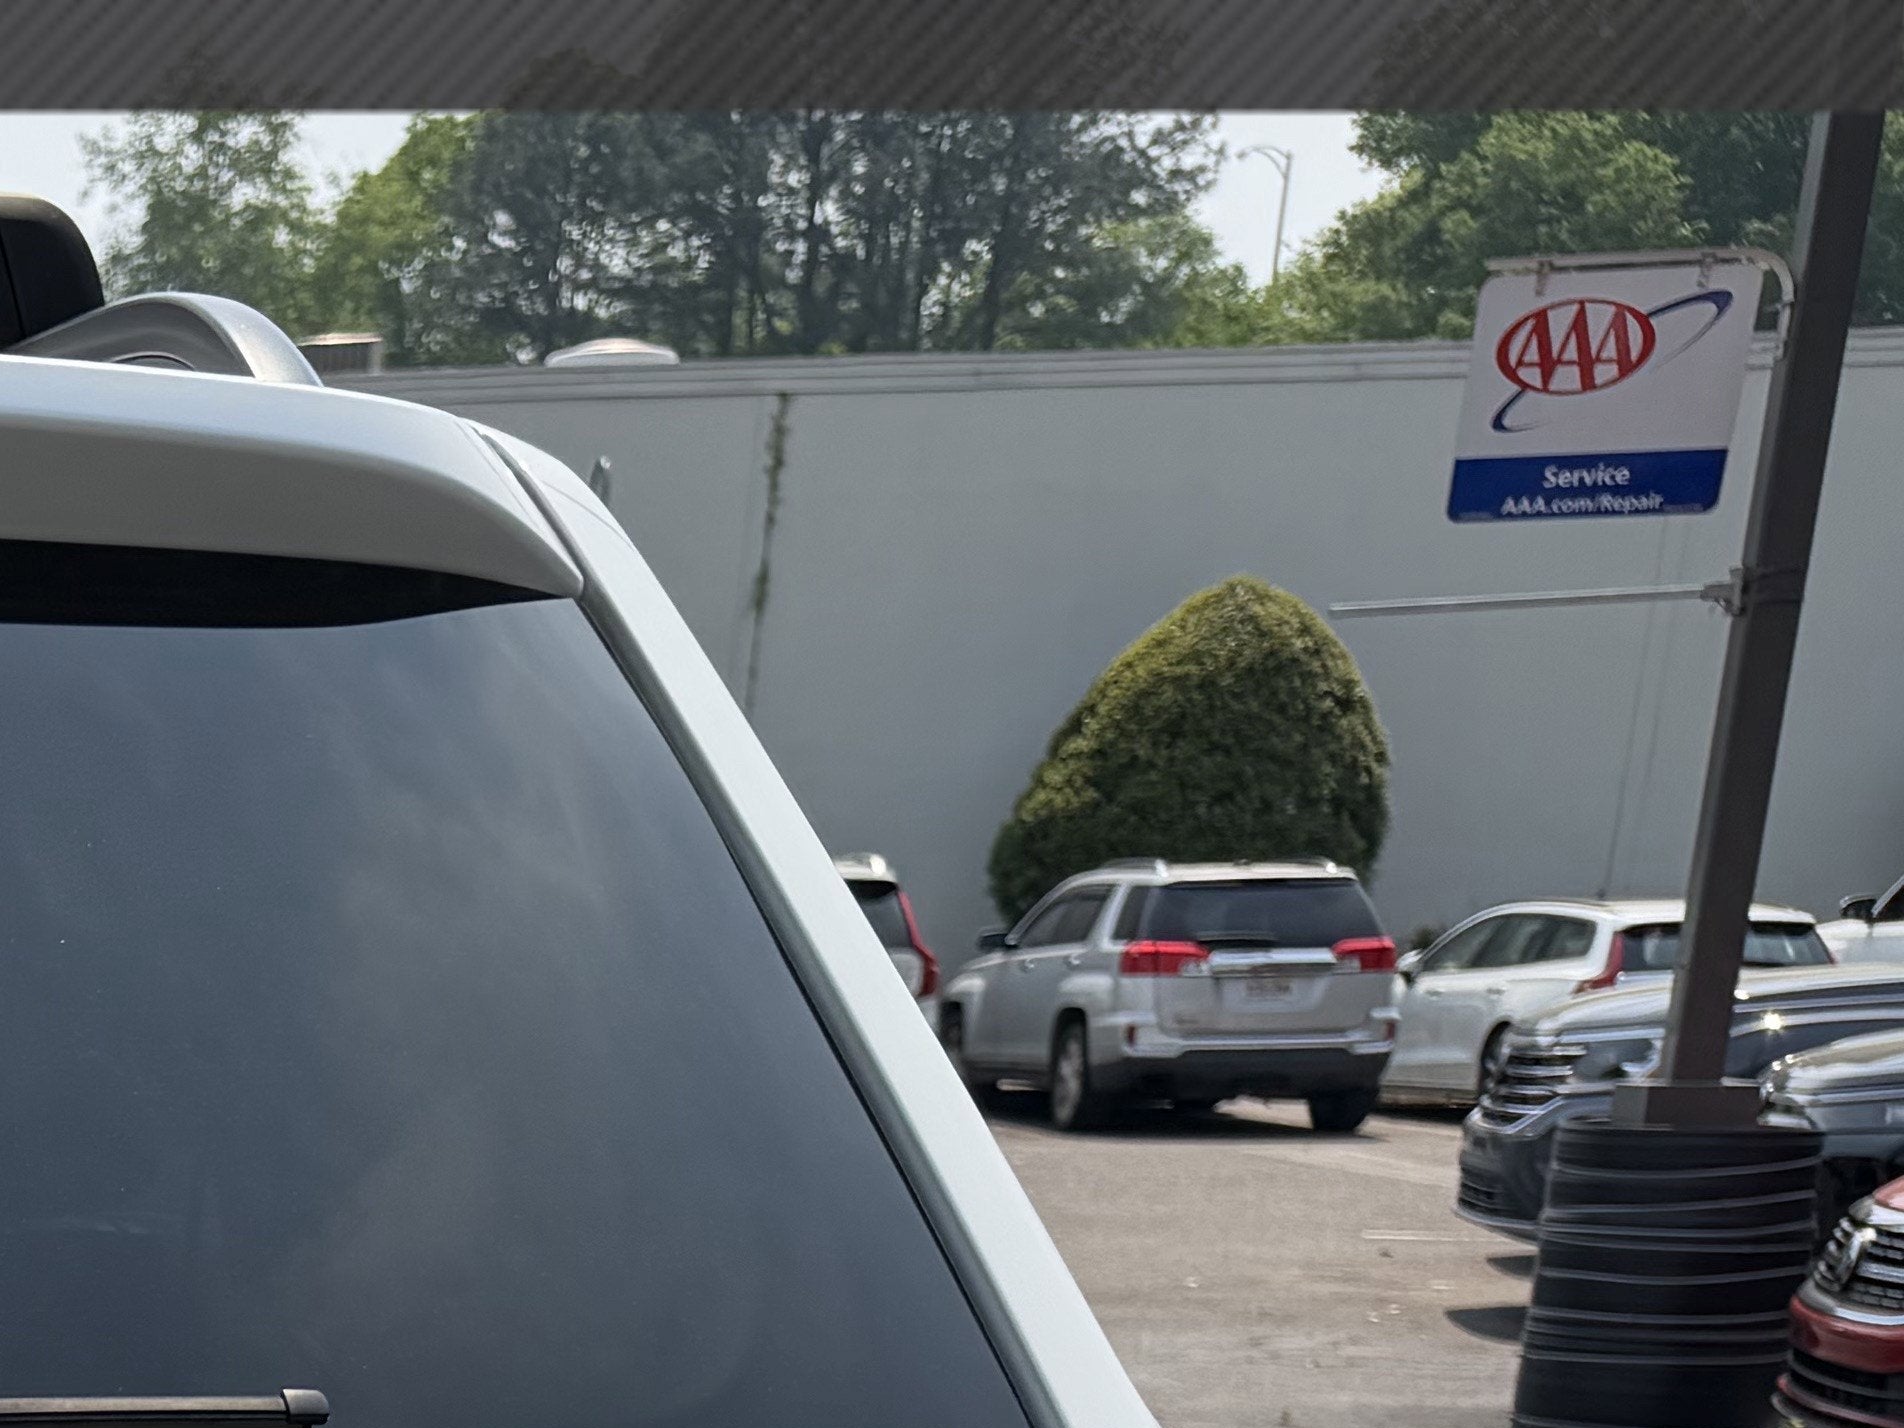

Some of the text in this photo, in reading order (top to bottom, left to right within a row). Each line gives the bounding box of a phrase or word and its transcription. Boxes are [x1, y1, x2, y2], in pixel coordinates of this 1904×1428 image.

[1514, 300, 1635, 393] AAA
[1543, 462, 1631, 489] Service
[1501, 491, 1664, 516] AAA.com/Repair
